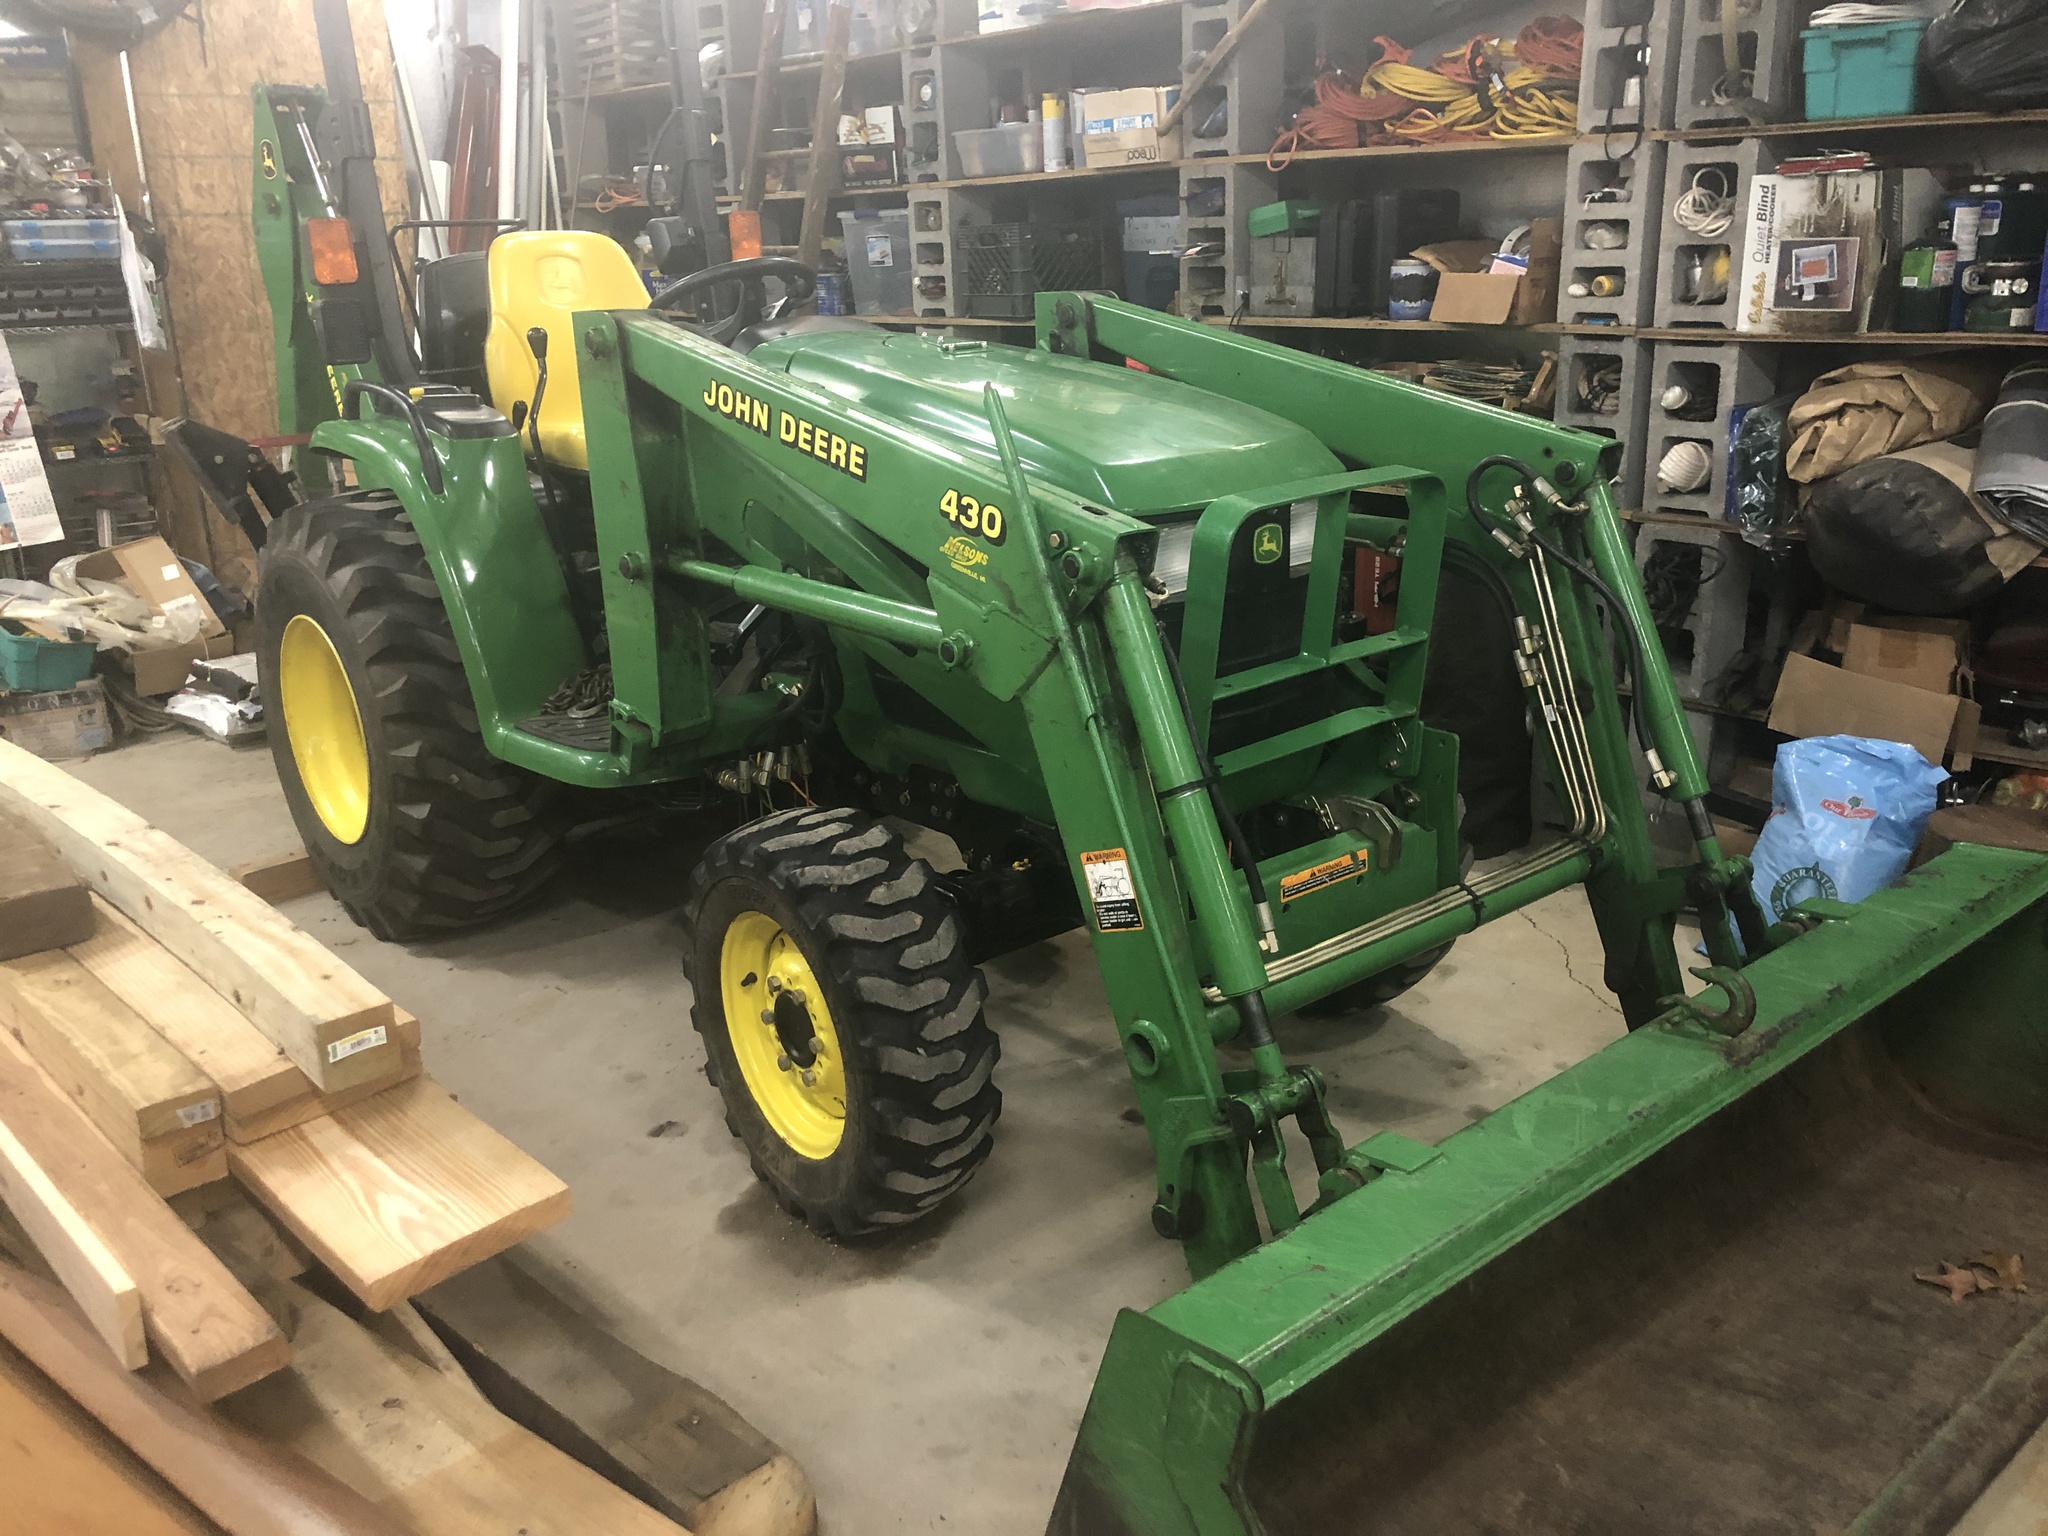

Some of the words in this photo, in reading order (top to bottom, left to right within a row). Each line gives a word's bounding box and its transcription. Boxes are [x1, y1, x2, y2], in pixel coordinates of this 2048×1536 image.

[1757, 184, 1770, 222] Blind
[1764, 183, 1777, 264] HEATER/COOKER
[1752, 225, 1767, 263] Quiet
[703, 378, 771, 437] JOHN
[780, 410, 868, 482] DEERE
[939, 488, 1006, 546] 430
[1824, 801, 1842, 814] Our
[1093, 850, 1122, 861] WARNING
[1316, 860, 1343, 874] WARNING
